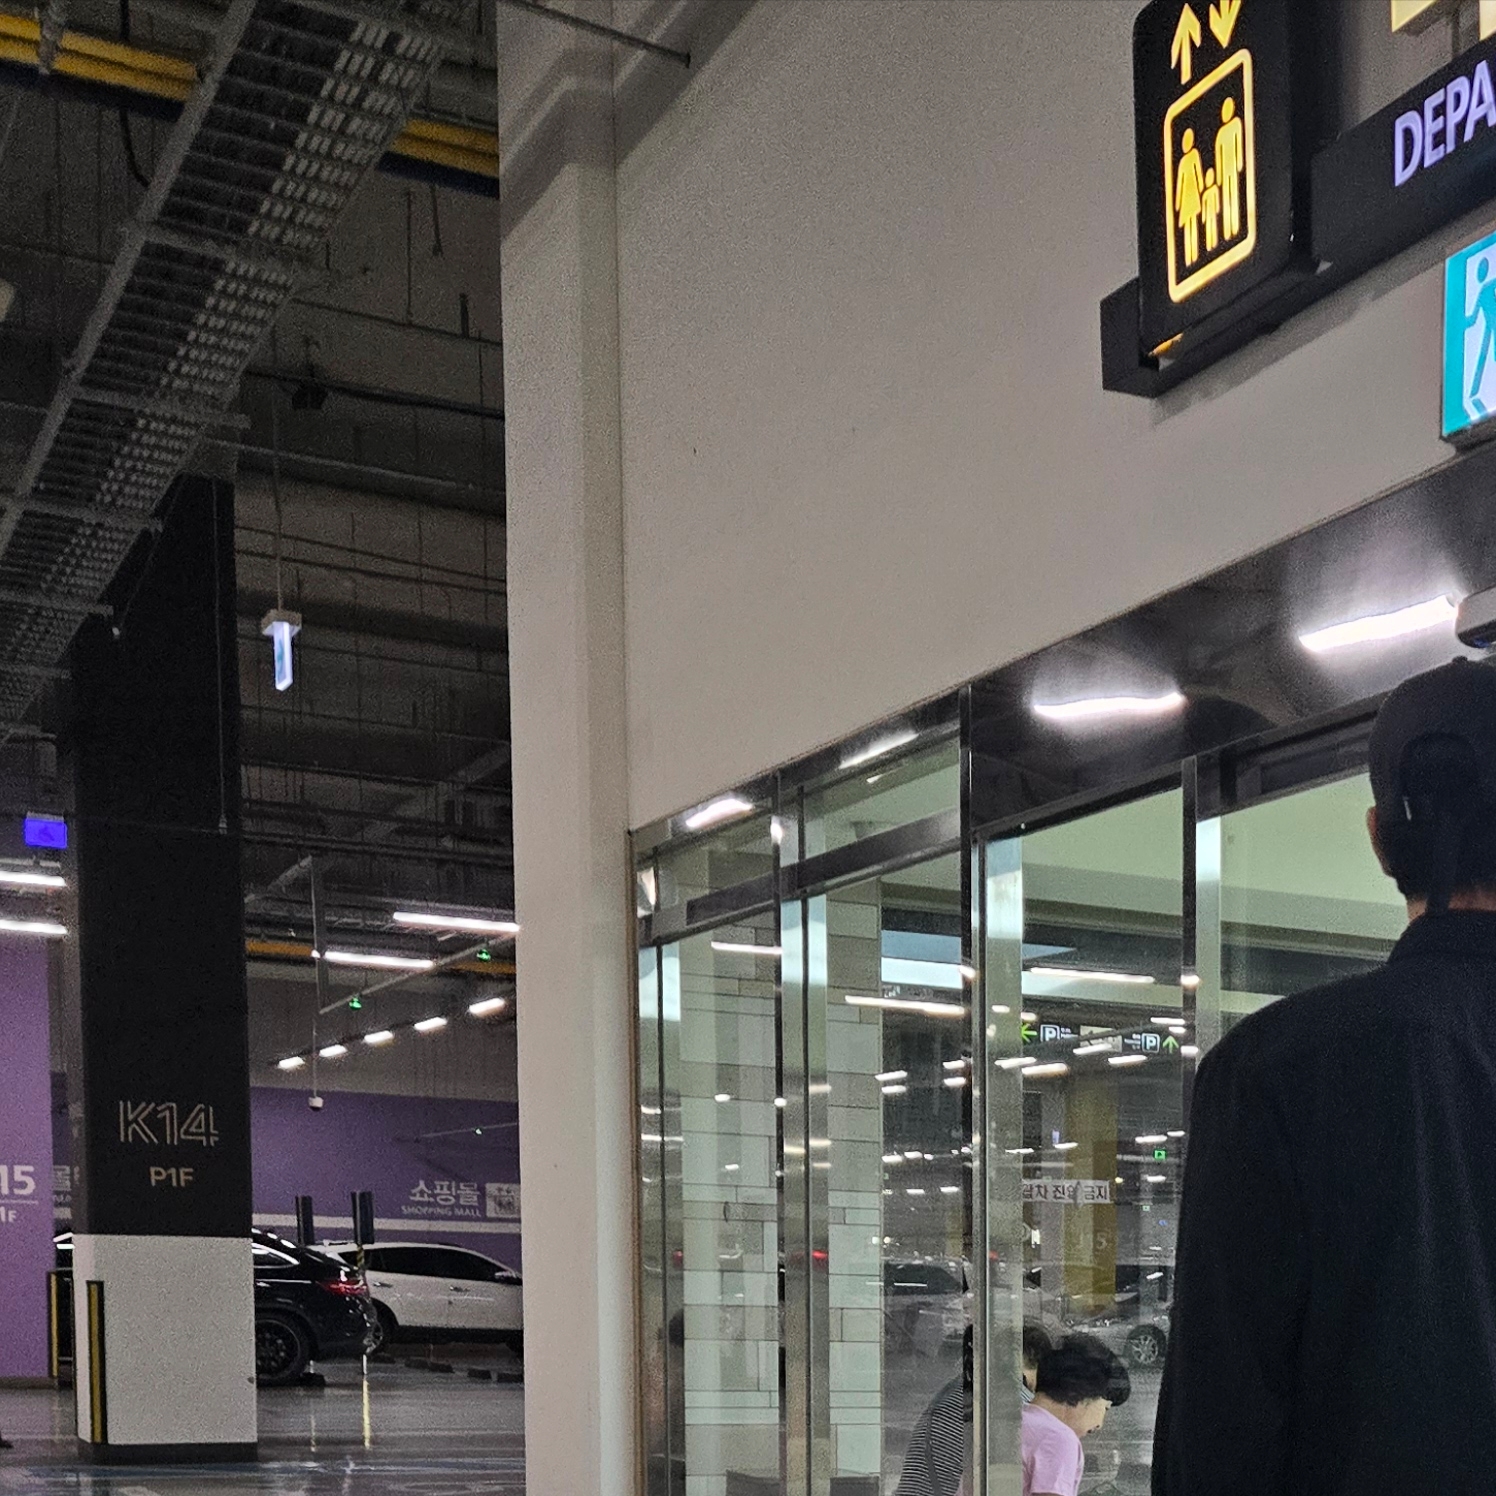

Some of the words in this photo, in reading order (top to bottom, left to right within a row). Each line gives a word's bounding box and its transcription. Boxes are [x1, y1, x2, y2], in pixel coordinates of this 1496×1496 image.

[119, 1100, 219, 1147] K14
[149, 1166, 194, 1187] P1F
[409, 1180, 481, 1206] 쇼핑몰
